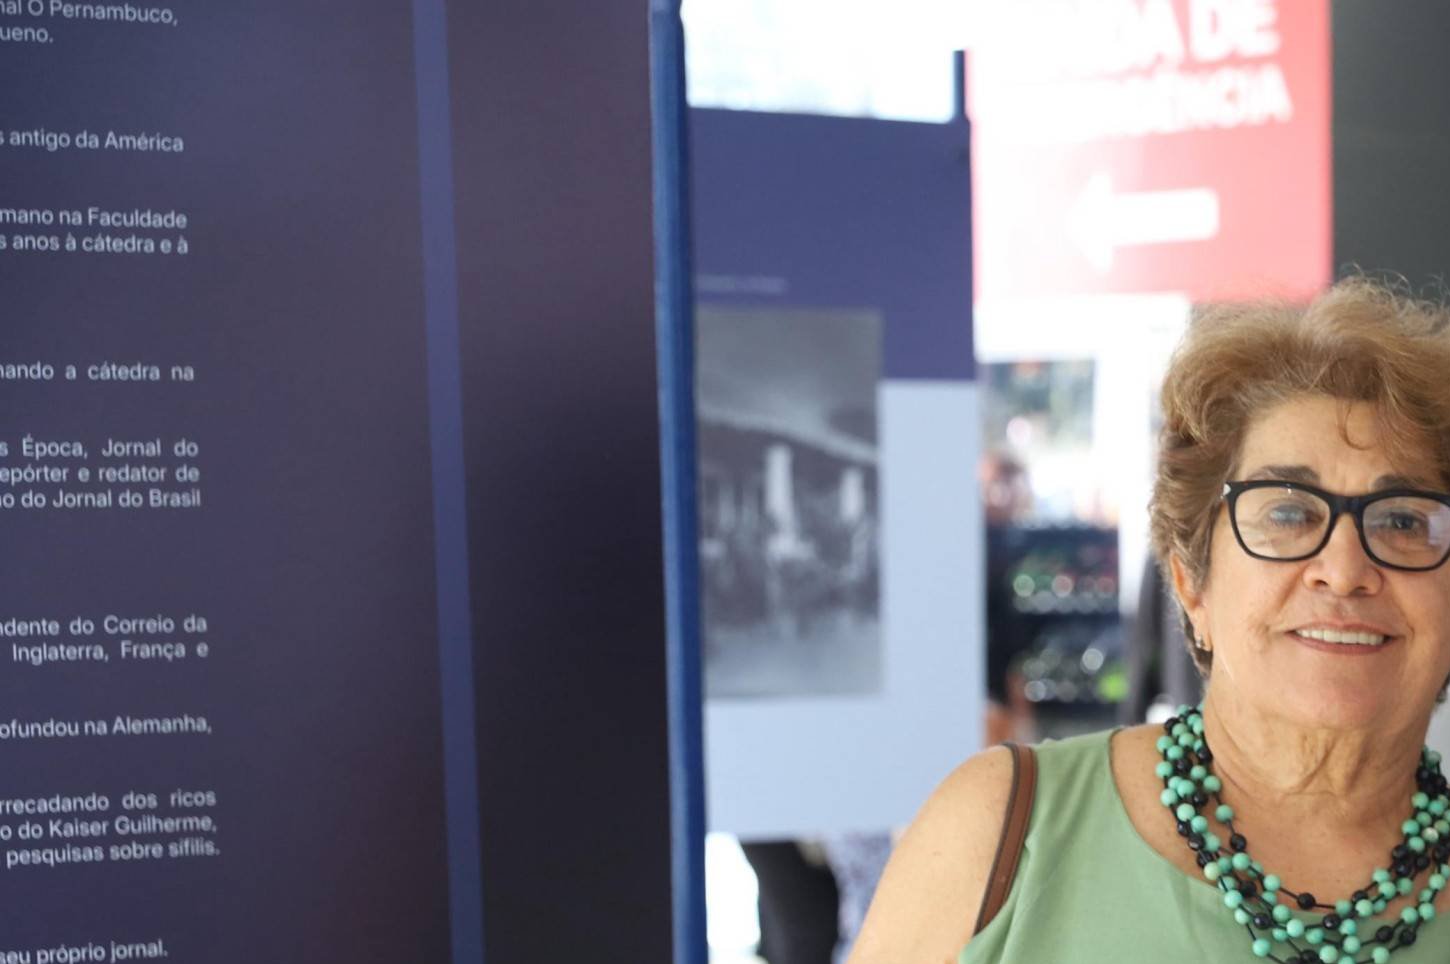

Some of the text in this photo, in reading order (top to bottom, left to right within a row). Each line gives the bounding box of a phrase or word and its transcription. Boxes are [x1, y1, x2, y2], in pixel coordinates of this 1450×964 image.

[28, 0, 44, 16] O
[50, 0, 177, 26] Pernambuco,
[10, 128, 70, 151] antigo
[75, 130, 99, 148] da
[105, 131, 183, 152] América
[59, 211, 82, 225] na
[88, 207, 187, 228] Faculdade
[13, 235, 59, 250] anos
[65, 233, 76, 251] à
[82, 234, 154, 253] cátedra
[160, 239, 171, 253] e
[177, 236, 188, 254] à
[66, 365, 76, 379] a
[88, 362, 160, 380] cátedra
[171, 366, 194, 381] na
[23, 434, 87, 460] Época,
[102, 439, 161, 457] Jornal
[174, 438, 198, 456] do
[78, 468, 89, 482] e
[99, 464, 166, 482] redator
[176, 464, 199, 482] de
[21, 490, 46, 507] do
[53, 489, 112, 507] Jornal
[119, 489, 143, 507] do
[149, 489, 200, 507] Brasil
[70, 617, 94, 635] do
[104, 615, 174, 634] Correio
[184, 615, 207, 632] da
[13, 640, 208, 665] Inglaterra, França e
[85, 721, 107, 735] na
[112, 715, 211, 734] Alemanha,
[122, 791, 157, 809] dos
[170, 789, 216, 807] ricos
[18, 821, 43, 839] do
[49, 819, 108, 837] Kaiser
[115, 815, 216, 835] Guilherme,
[7, 844, 104, 869] pesquisas
[110, 841, 163, 860] sobre
[111, 939, 167, 963] jornal.
